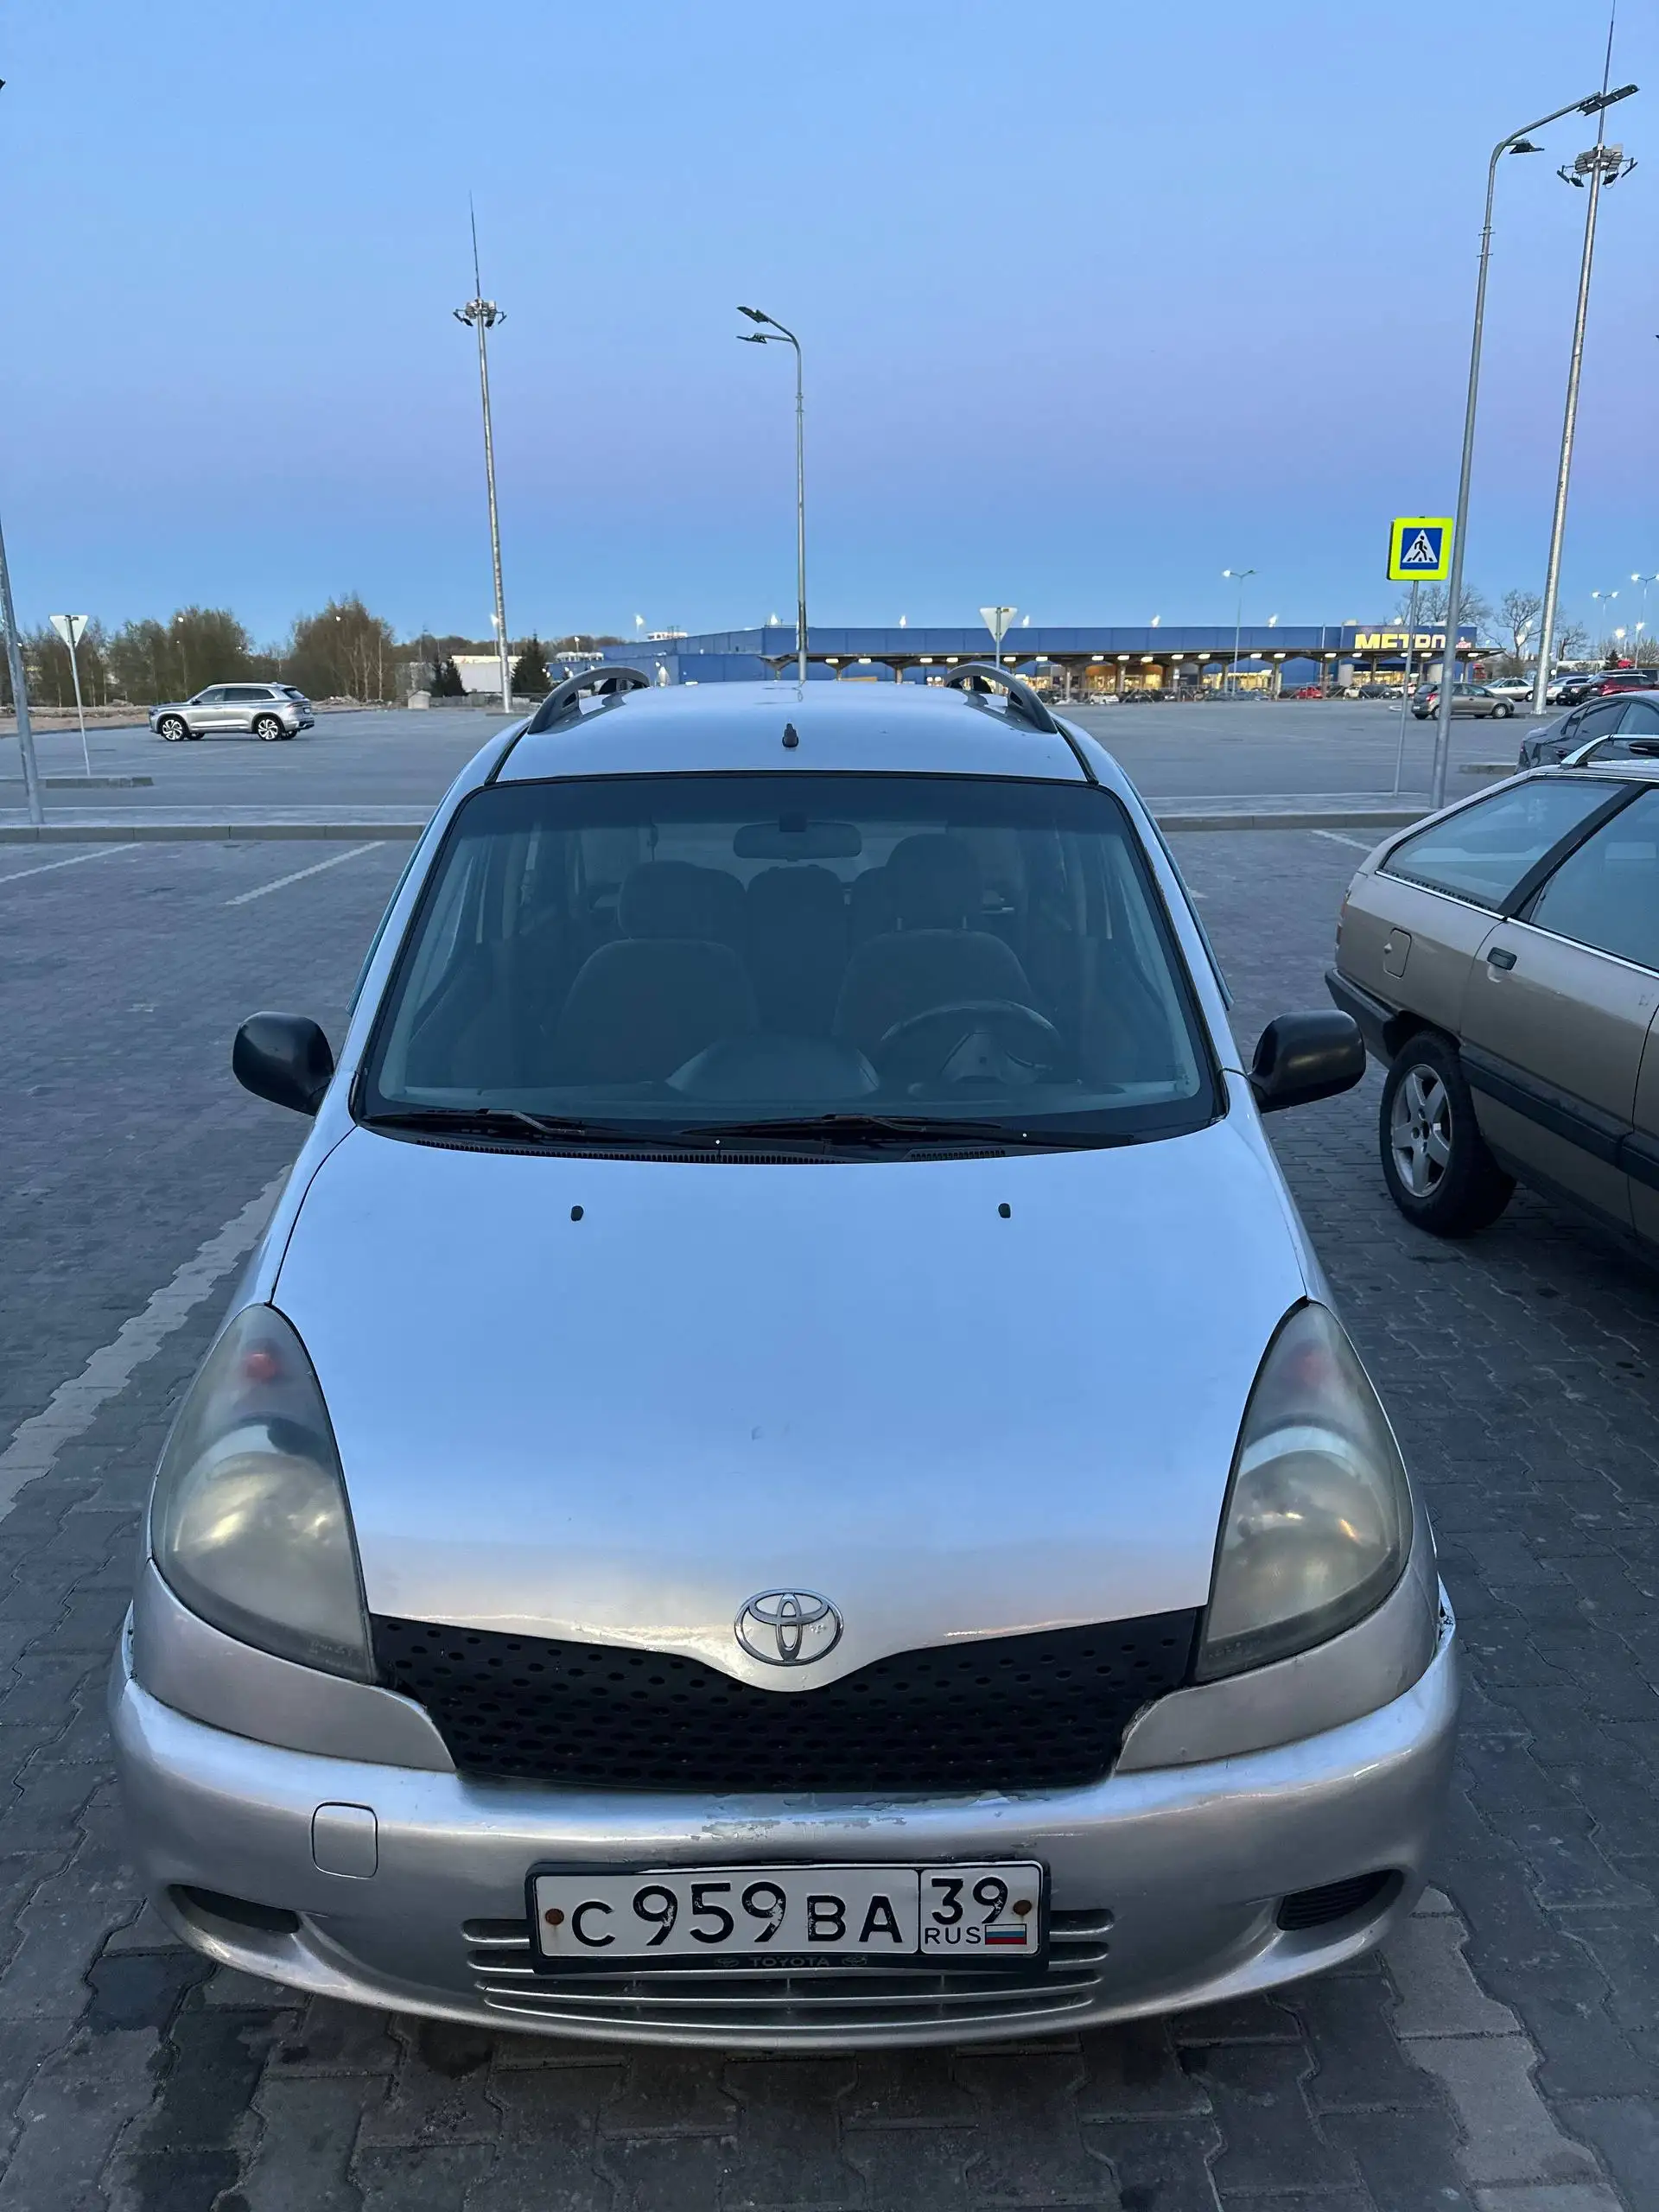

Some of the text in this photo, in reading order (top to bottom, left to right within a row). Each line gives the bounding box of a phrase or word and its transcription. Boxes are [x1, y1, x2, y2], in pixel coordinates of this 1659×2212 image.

[931, 1877, 1008, 1925] 39
[925, 1927, 982, 1944] RUS
[749, 1956, 830, 1967] TOYOTA
